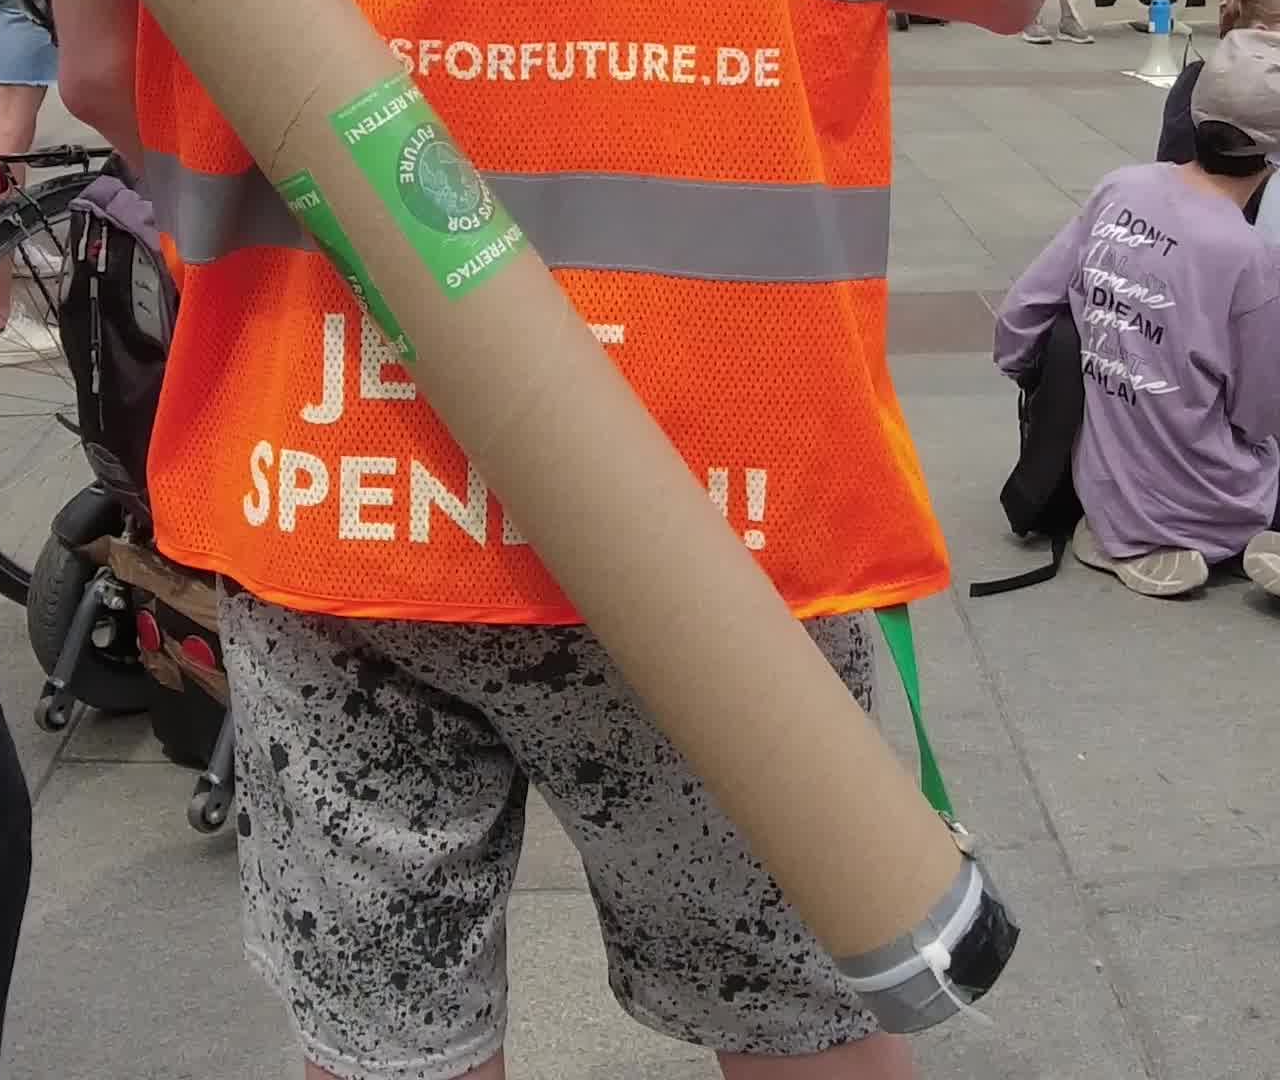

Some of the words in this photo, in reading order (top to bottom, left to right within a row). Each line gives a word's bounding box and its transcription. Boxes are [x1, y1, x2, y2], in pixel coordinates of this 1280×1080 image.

[345, 97, 409, 145] RETTEN!
[400, 124, 435, 184] FUTURE
[447, 215, 480, 233] FOR
[447, 237, 508, 288] FREITAG
